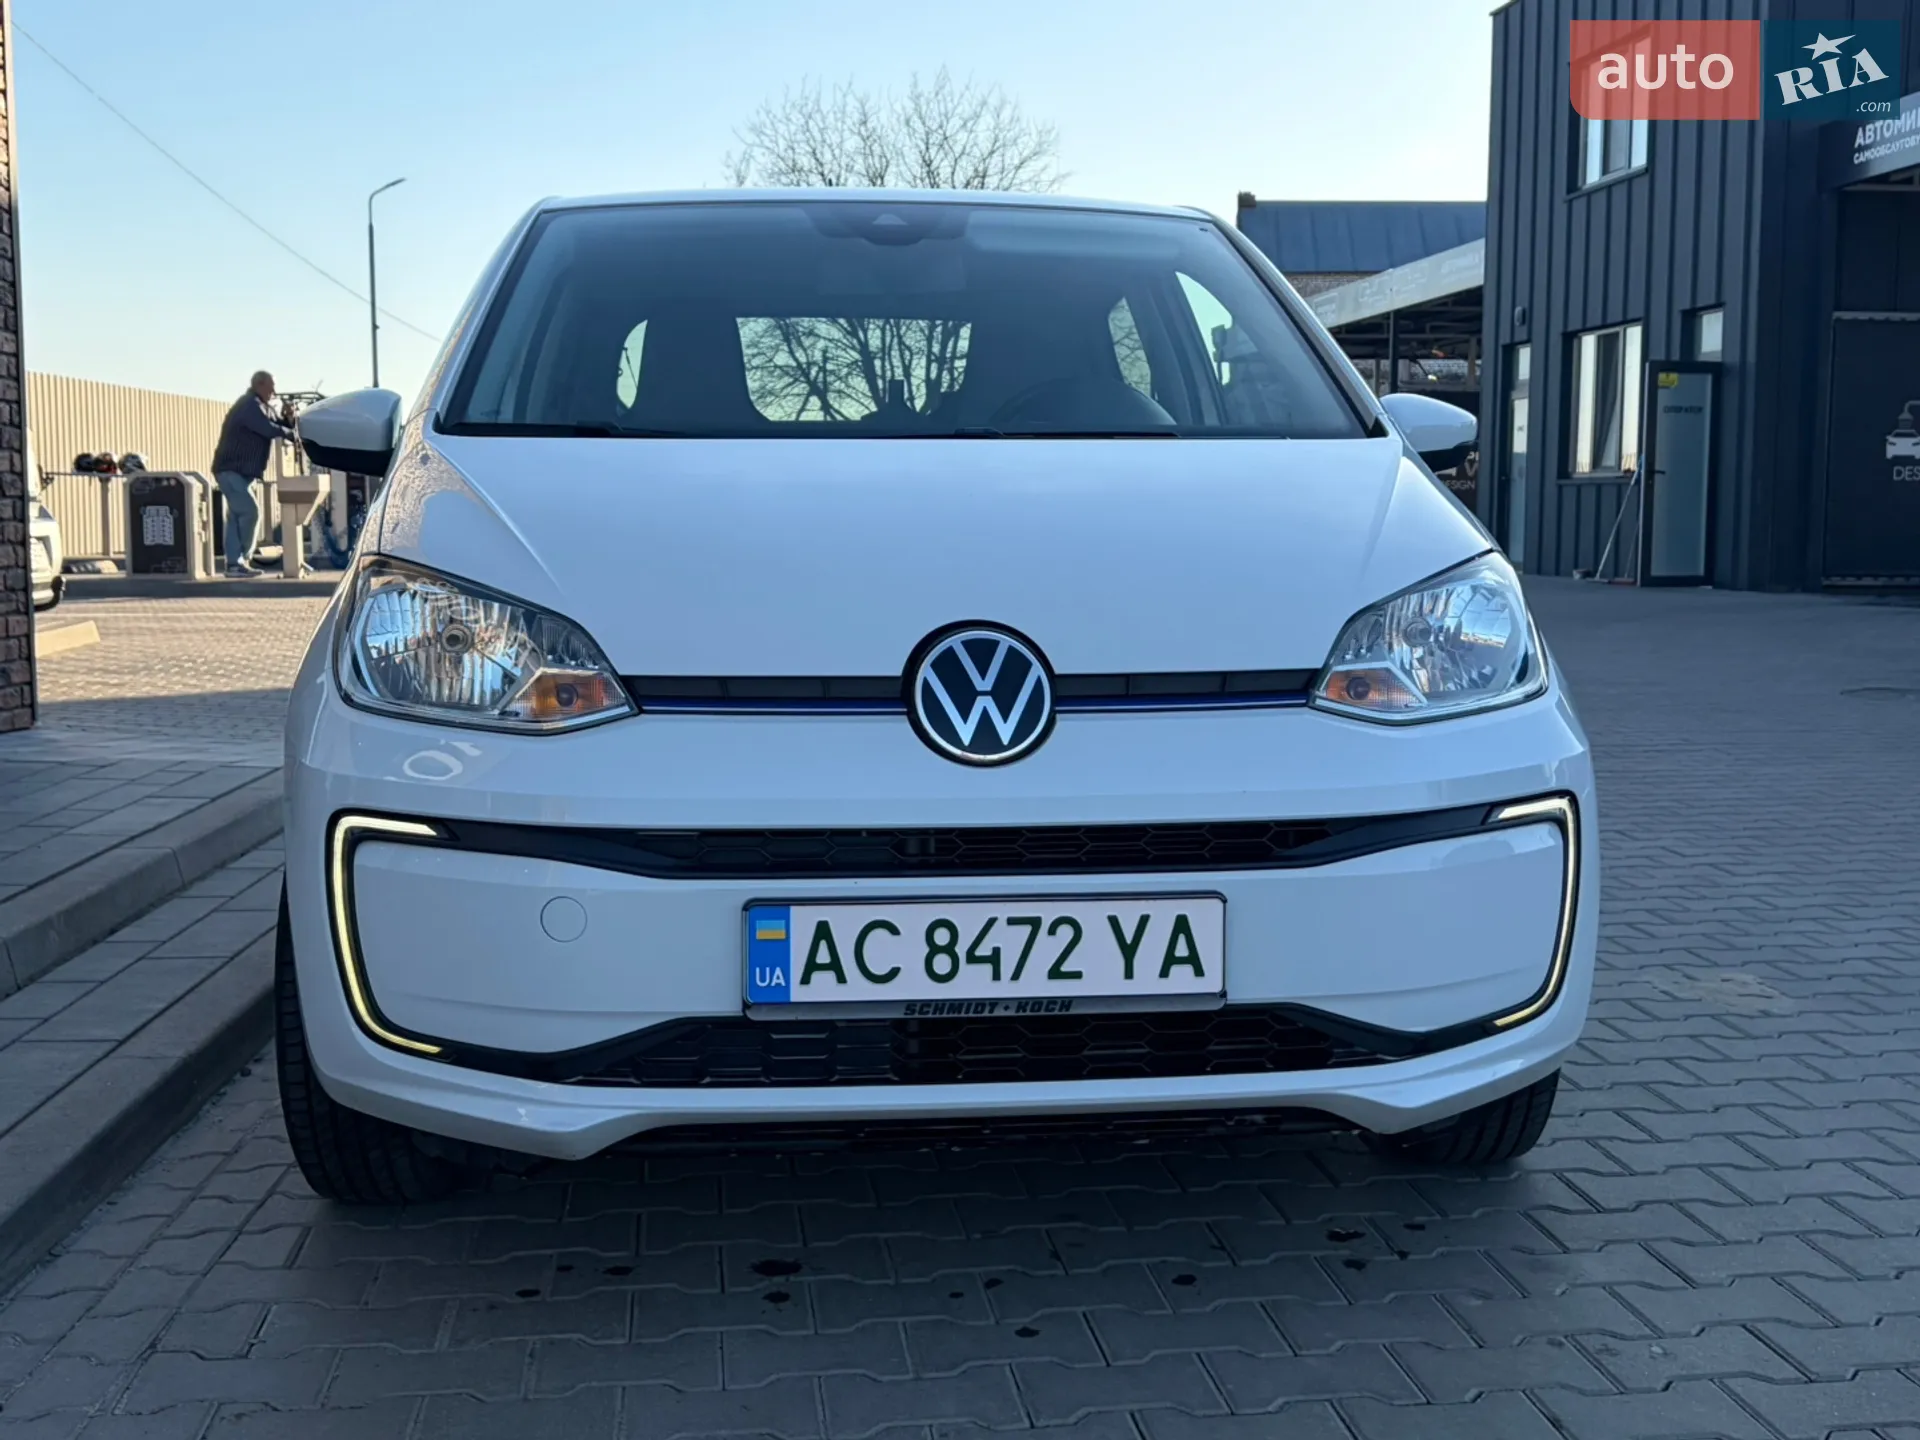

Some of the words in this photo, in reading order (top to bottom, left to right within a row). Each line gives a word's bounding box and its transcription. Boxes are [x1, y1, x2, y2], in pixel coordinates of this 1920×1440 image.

[1443, 479, 1476, 490] ESIGN
[799, 918, 902, 985] AC
[924, 915, 1084, 984] 8472
[1106, 913, 1206, 980] YA
[755, 967, 786, 987] UA
[903, 1001, 999, 1016] SCHMIDT
[1014, 999, 1074, 1014] KOCH
